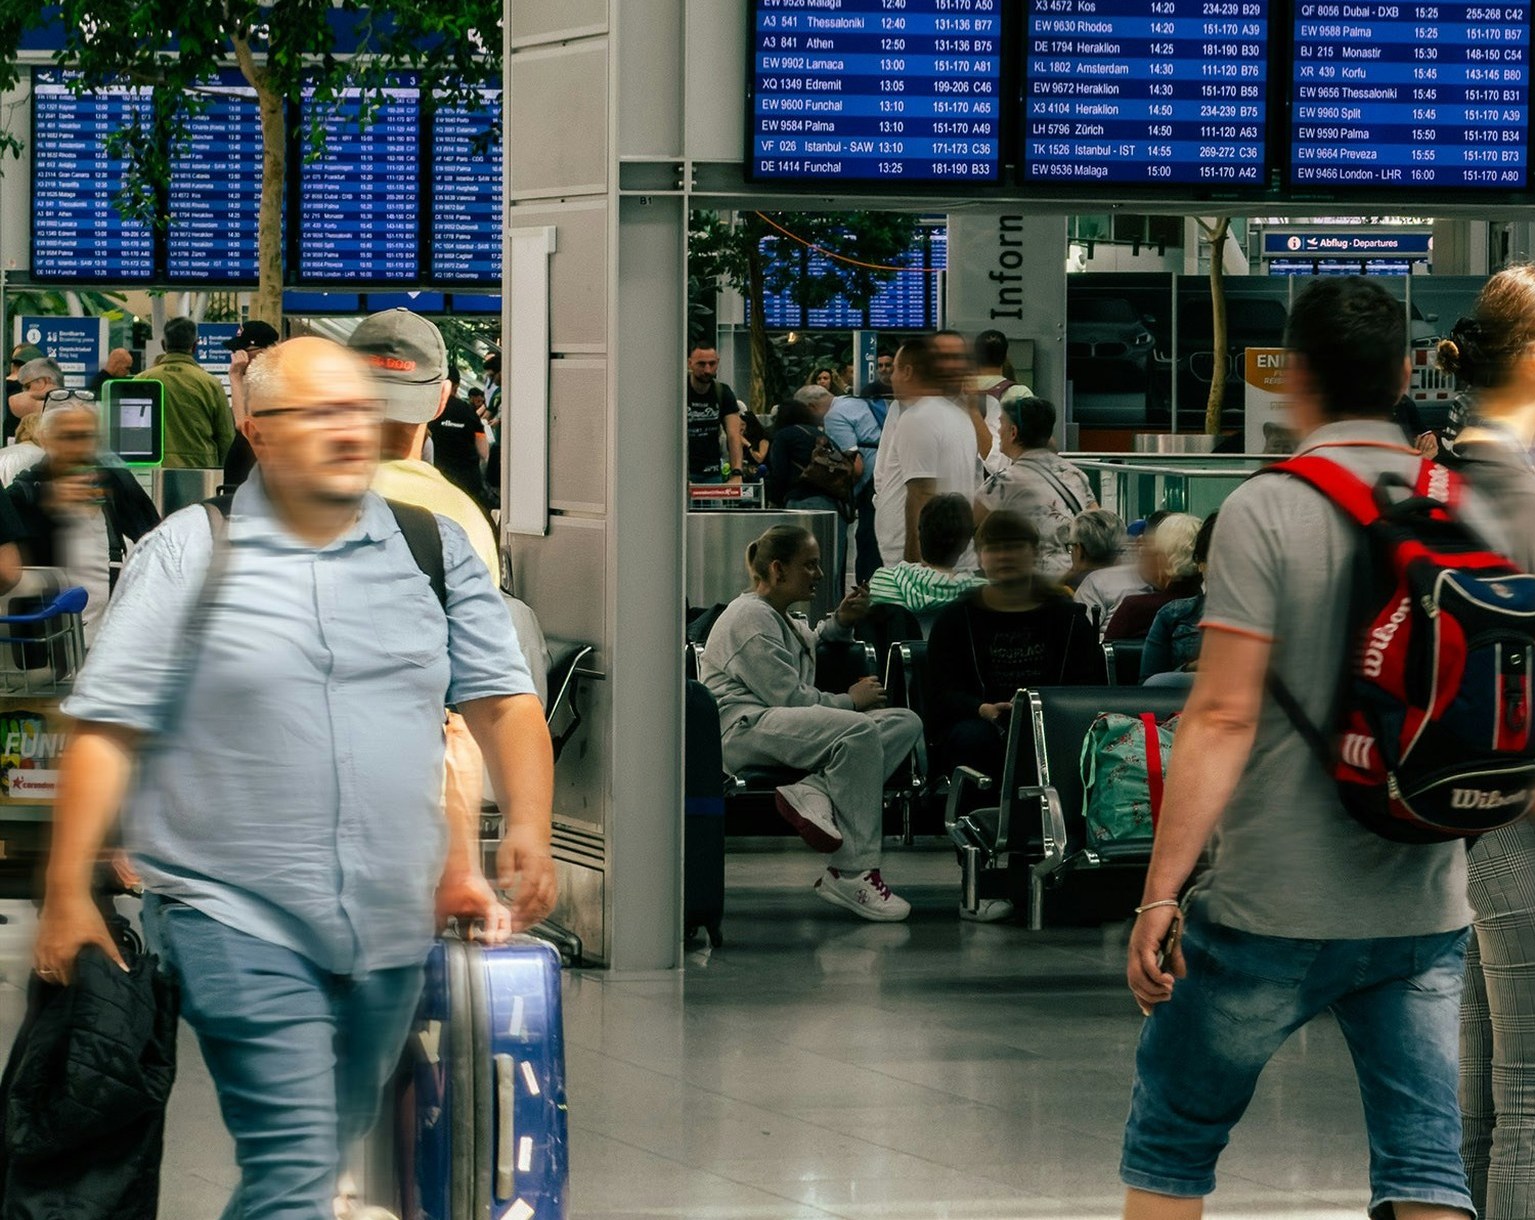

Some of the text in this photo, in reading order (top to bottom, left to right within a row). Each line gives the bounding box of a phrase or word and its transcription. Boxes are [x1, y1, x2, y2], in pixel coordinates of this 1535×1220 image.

[763, 15, 992, 31] A3 541 Thessaloniki 12:40 131-136 B77
[1301, 45, 1522, 61] BJ 215 Monastir 15:30 148-150 C54
[1034, 61, 1259, 77] KL 1802 Amsterdam 14:30 111-120 B76
[762, 78, 992, 93] XQ 1349 Edremit 13:05 199-206 C46
[1033, 123, 1258, 138] LH 5796 Zürich 14:50 111-120 A63
[761, 160, 990, 175] DE 1414 Funchal 13:25 181-190 B33
[1298, 167, 1315, 179] EW
[1316, 168, 1338, 179] 9466
[1339, 168, 1373, 180] London
[1381, 169, 1402, 180] LHR
[1411, 169, 1435, 181] 16:00
[1463, 170, 1498, 181] 151-170
[1501, 170, 1519, 182] A80
[1320, 238, 1398, 250] Abflug Departures
[1363, 597, 1411, 678] Wilson
[5, 732, 65, 757] FUN!
